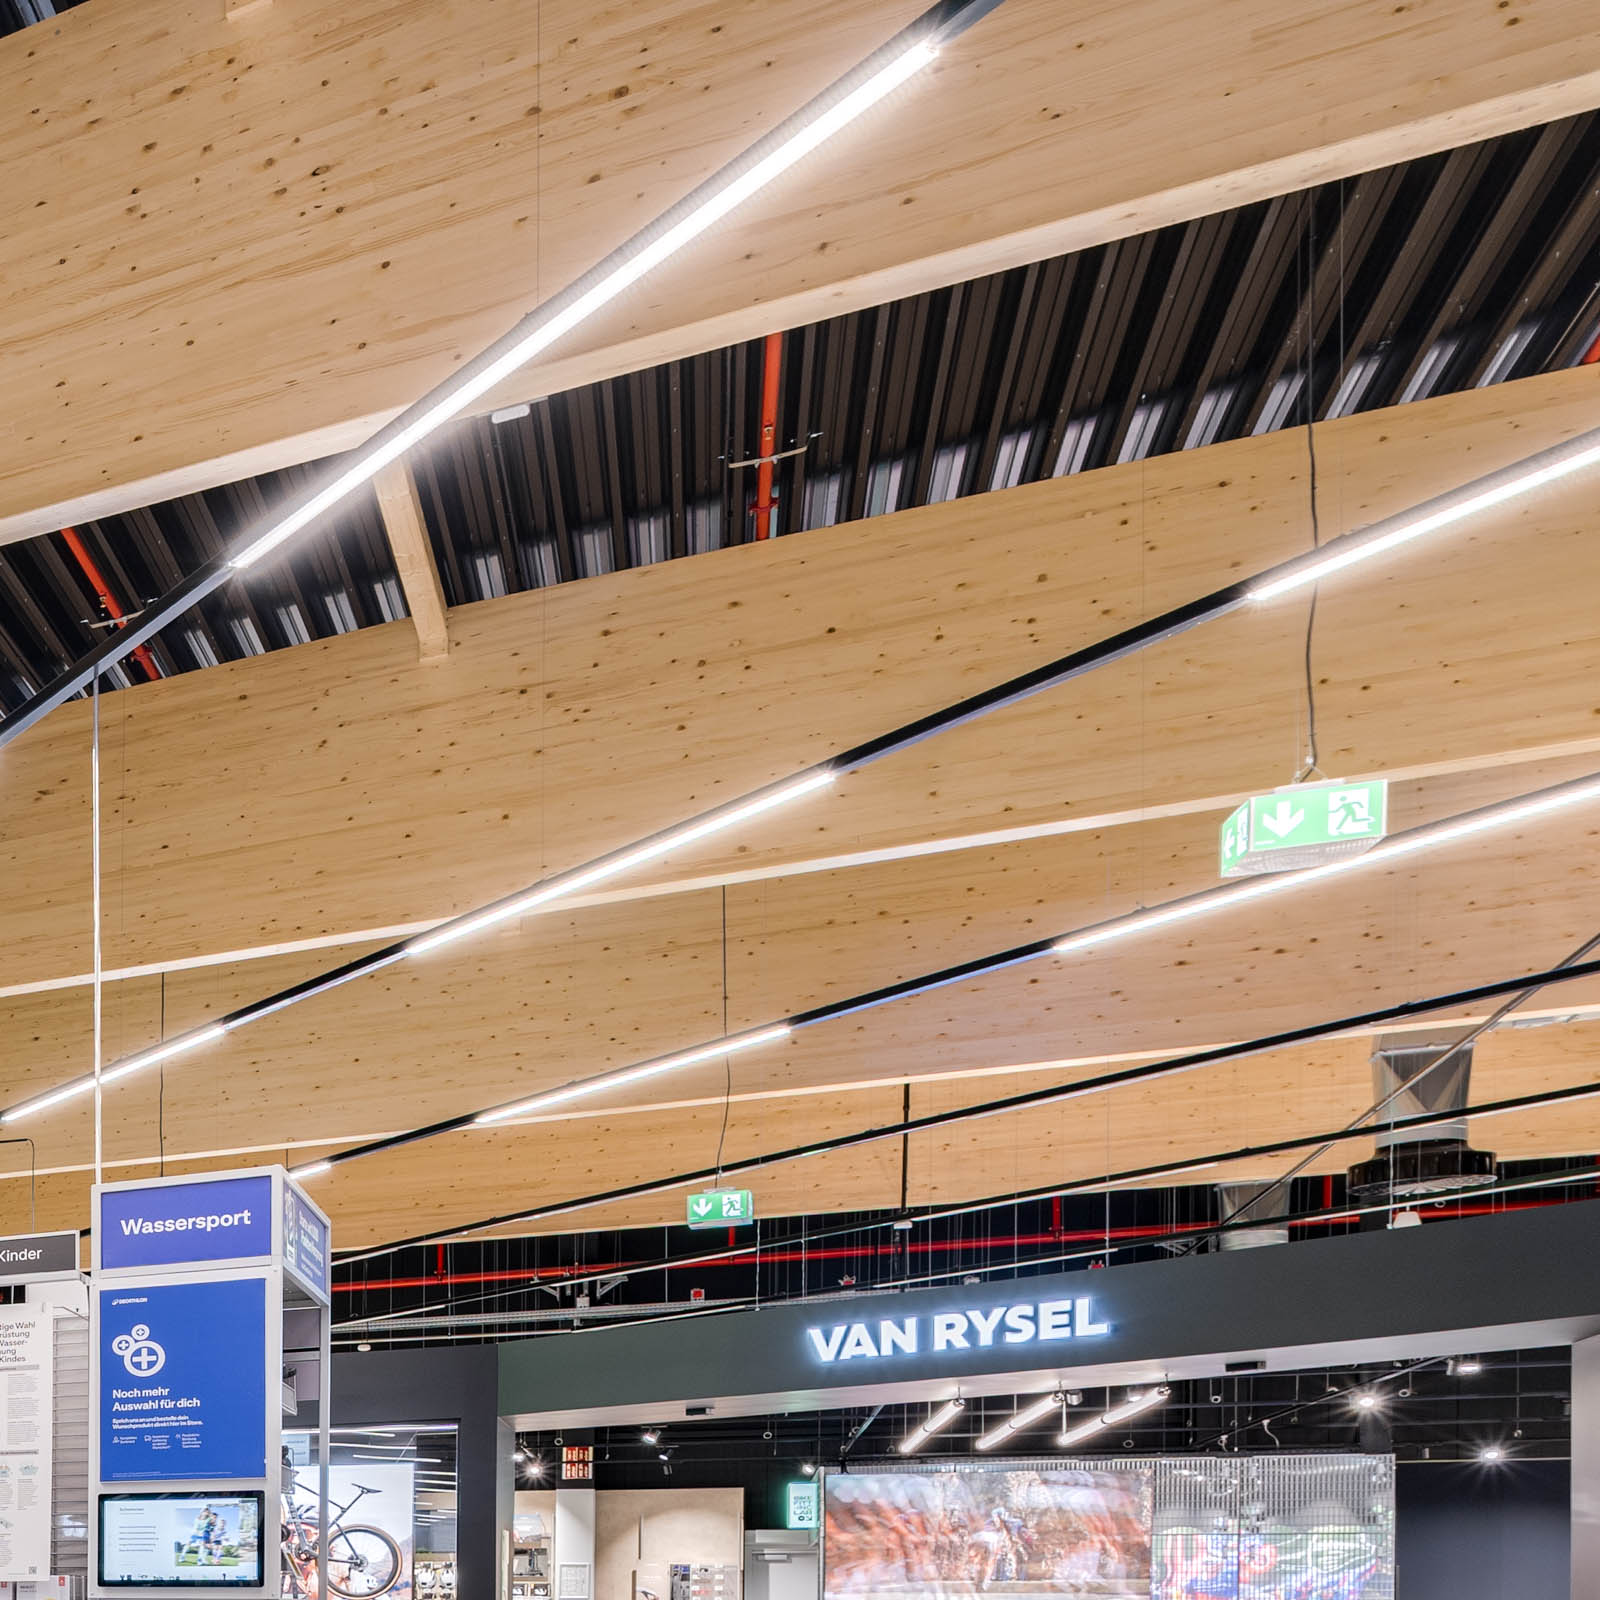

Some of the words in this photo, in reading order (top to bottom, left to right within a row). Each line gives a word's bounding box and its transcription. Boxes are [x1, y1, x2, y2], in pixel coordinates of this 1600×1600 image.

[120, 1209, 252, 1236] Wassersport
[15, 1321, 36, 1329] Wahl
[807, 1316, 919, 1362] VAN
[933, 1296, 1110, 1351] RYSEL
[0, 1355, 27, 1364] Kindes
[112, 1387, 140, 1399] Noch
[142, 1386, 170, 1397] mehr
[112, 1399, 159, 1412] Auswahl
[160, 1399, 176, 1409] für
[177, 1397, 201, 1408] dich
